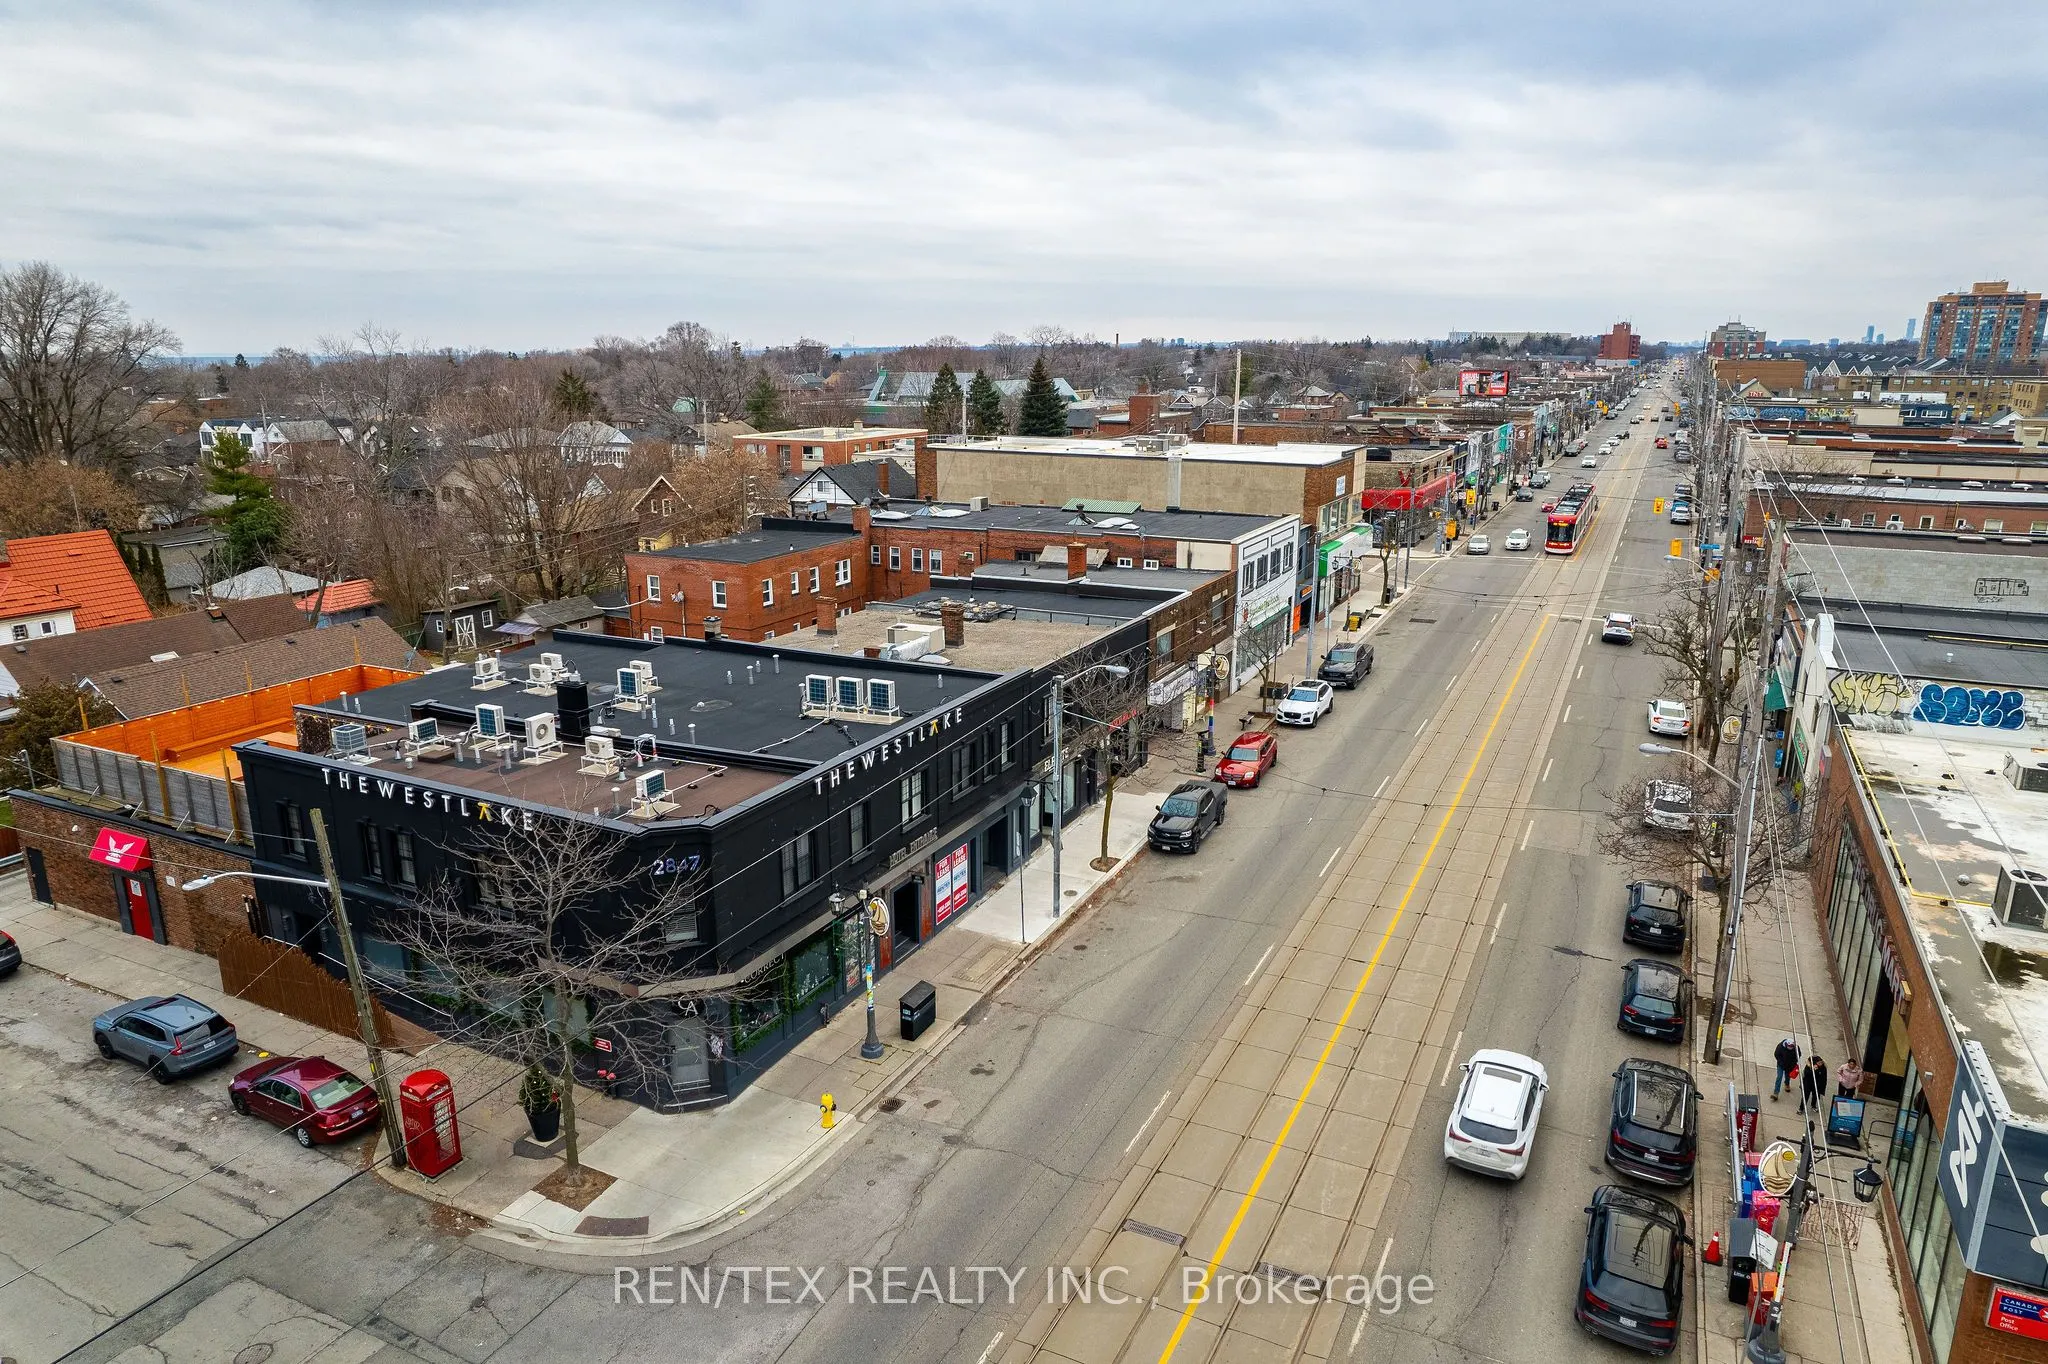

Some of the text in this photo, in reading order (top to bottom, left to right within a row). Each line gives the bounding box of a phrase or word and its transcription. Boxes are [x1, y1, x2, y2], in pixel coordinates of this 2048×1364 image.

[956, 847, 964, 858] FOR
[653, 855, 701, 876] 2847
[940, 858, 948, 869] FOR
[953, 853, 966, 867] LEASE
[937, 865, 950, 879] LEASE
[2005, 1298, 2038, 1310] CANADA
[2003, 1306, 2023, 1315] POST
[2001, 1316, 2015, 1324] Post
[1999, 1322, 2019, 1331] Office
